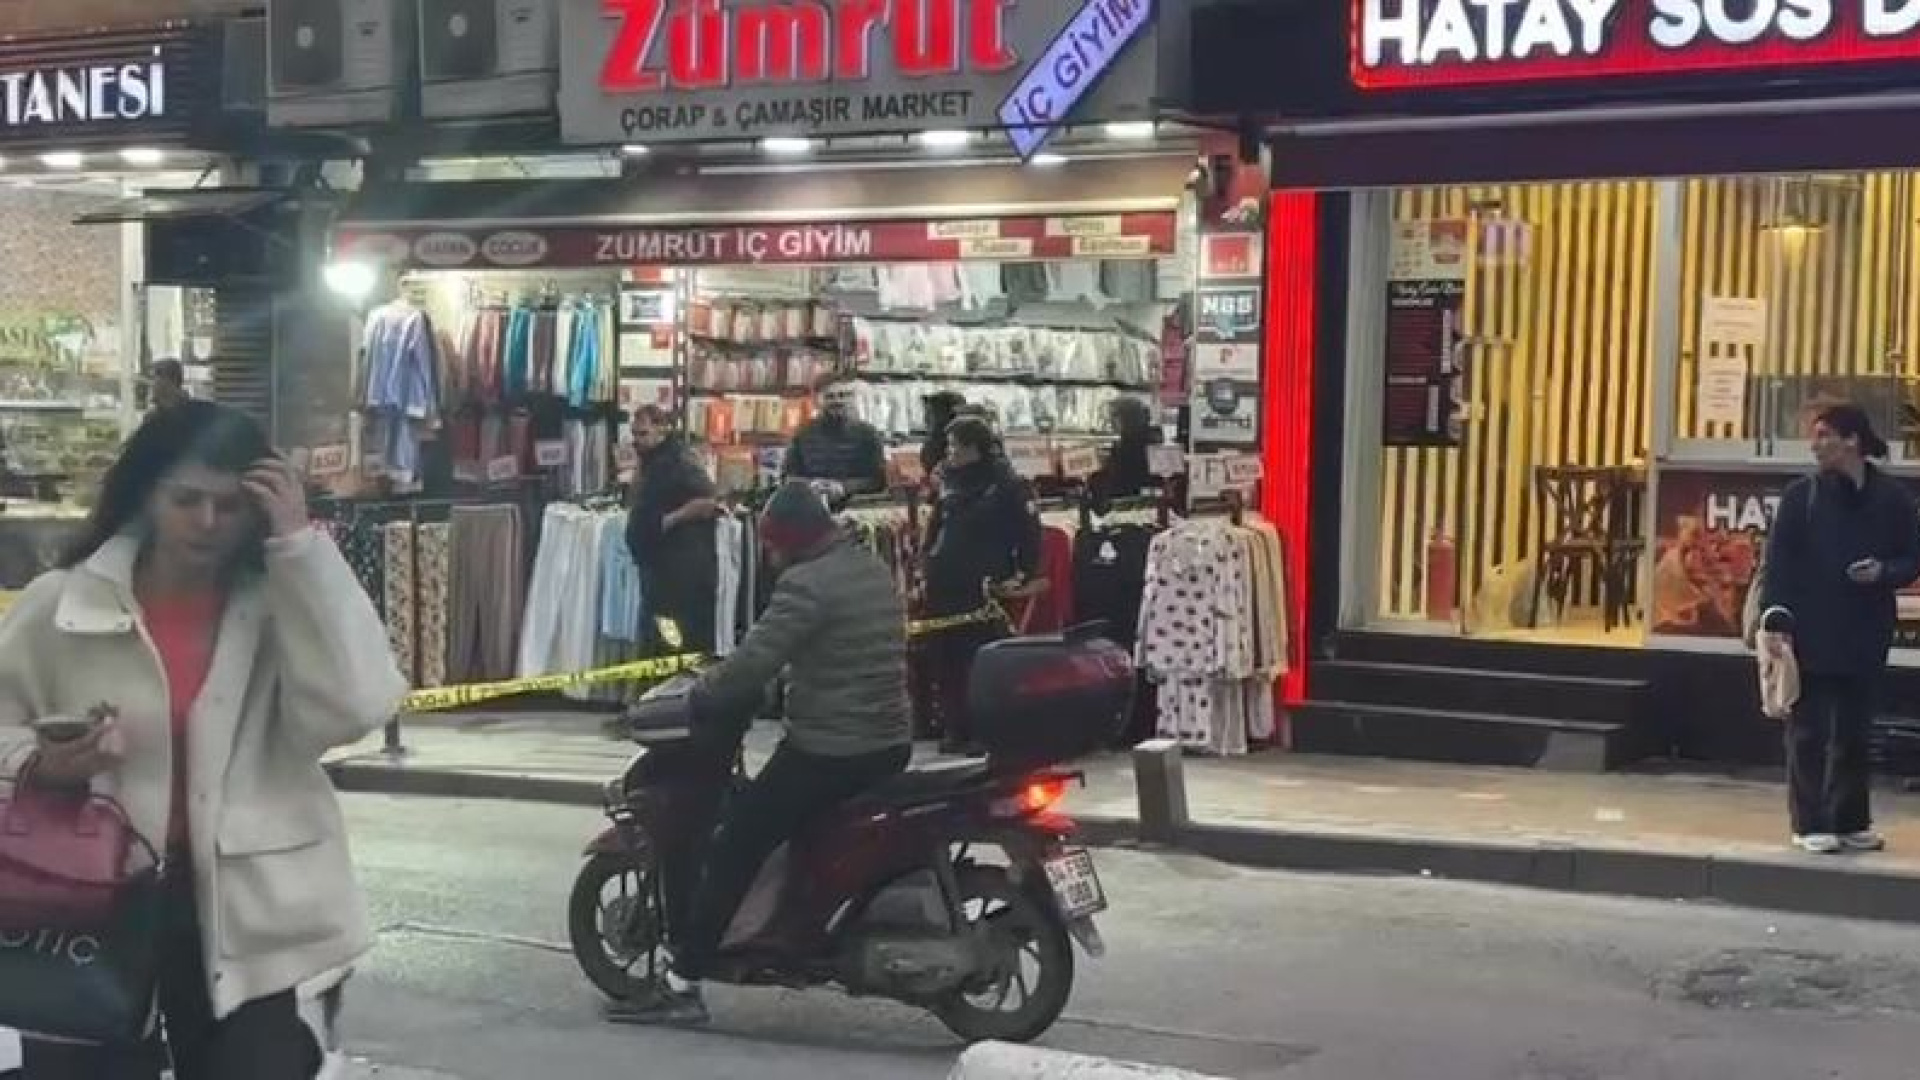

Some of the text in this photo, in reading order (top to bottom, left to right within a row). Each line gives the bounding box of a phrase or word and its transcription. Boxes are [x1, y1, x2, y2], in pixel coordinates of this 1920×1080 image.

[1363, 0, 1617, 66] HATAY
[0, 45, 164, 124] TANESİ
[621, 106, 706, 136] ÇORAP
[735, 98, 850, 131] ÇAMAŞIR
[862, 91, 973, 121] MARKET
